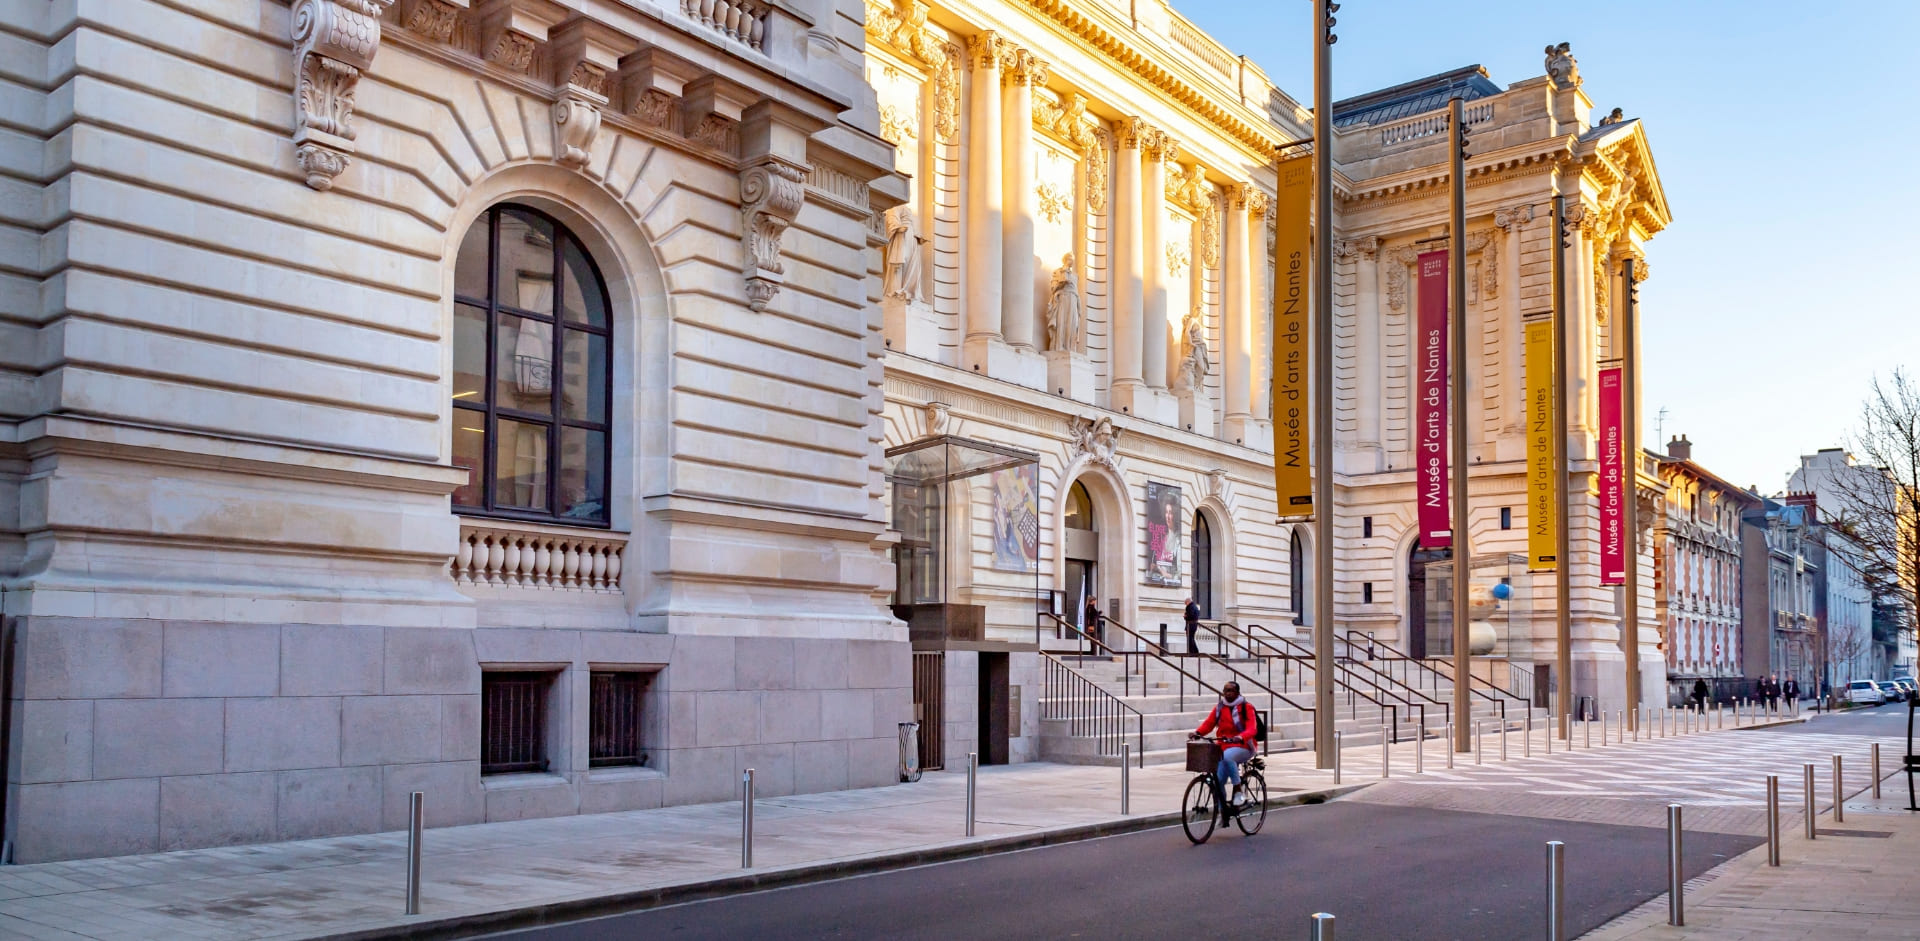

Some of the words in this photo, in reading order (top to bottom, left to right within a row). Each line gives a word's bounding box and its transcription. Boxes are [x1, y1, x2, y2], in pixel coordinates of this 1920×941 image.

[1283, 251, 1300, 316] Nantes
[1282, 321, 1299, 344] de
[1281, 350, 1299, 400] d'arts
[1424, 329, 1440, 383] Nantes
[1423, 387, 1440, 406] de
[1533, 387, 1546, 433] Nantes
[1284, 407, 1300, 468] Musée
[1423, 411, 1440, 453] d'arts
[1533, 436, 1547, 453] de
[1605, 425, 1617, 465] Nantes
[1425, 457, 1441, 507] Musée
[1534, 456, 1547, 491] d'arts
[1605, 468, 1617, 483] de
[1536, 495, 1549, 536] Musée
[1605, 485, 1618, 516] d'arts
[1606, 519, 1618, 556] Musée
